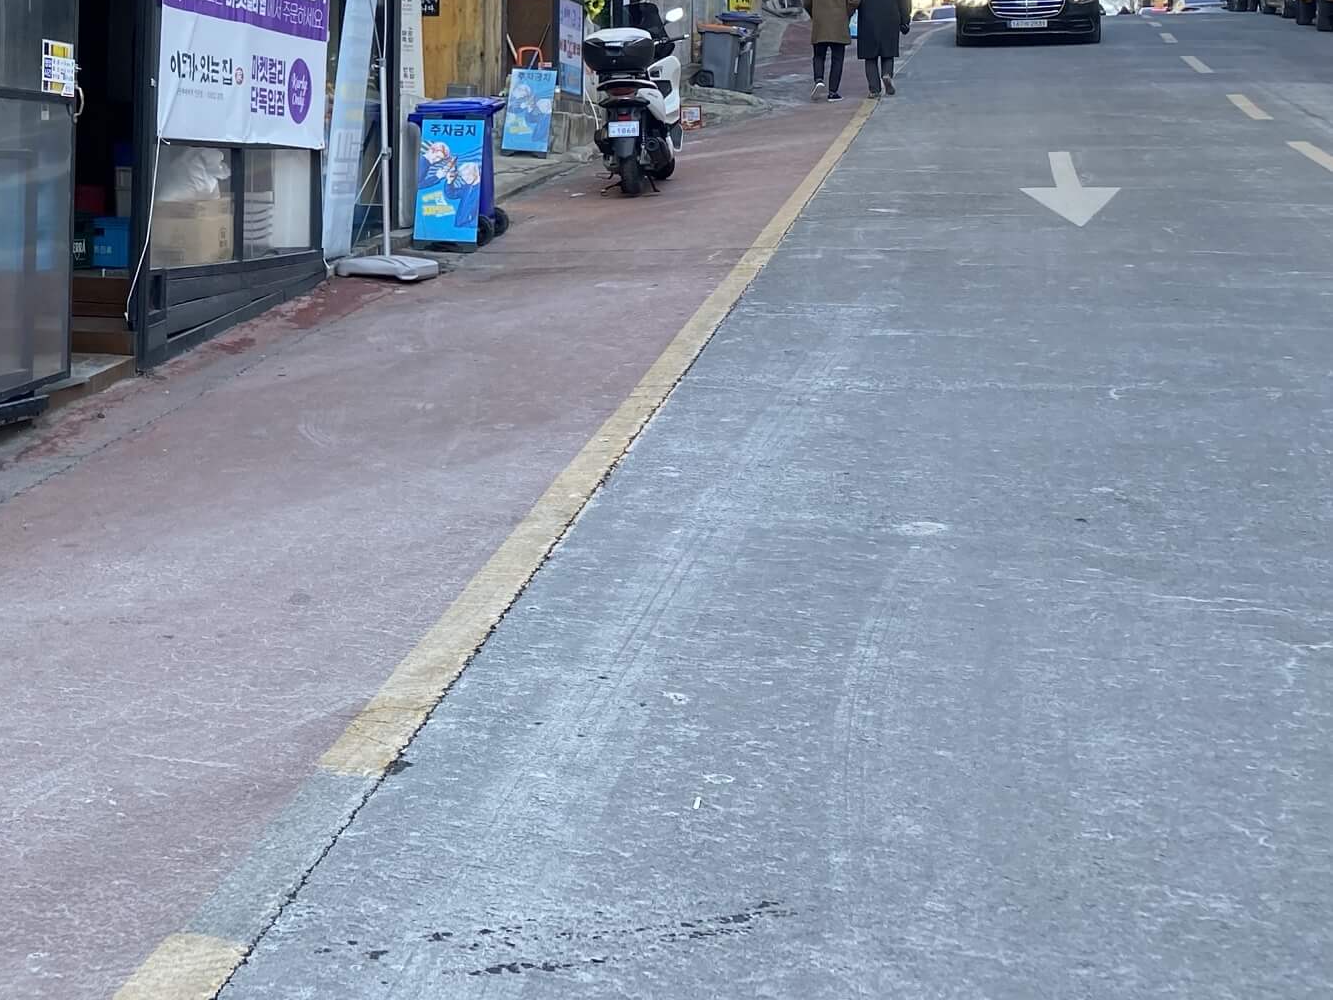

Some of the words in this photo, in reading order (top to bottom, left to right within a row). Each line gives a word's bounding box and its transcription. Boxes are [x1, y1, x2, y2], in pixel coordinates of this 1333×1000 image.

[282, 1, 325, 30] 주문하세요
[200, 55, 221, 84] 있는
[222, 58, 233, 86] 집
[251, 55, 287, 86] 마켓컬리
[250, 86, 286, 117] 단독입점
